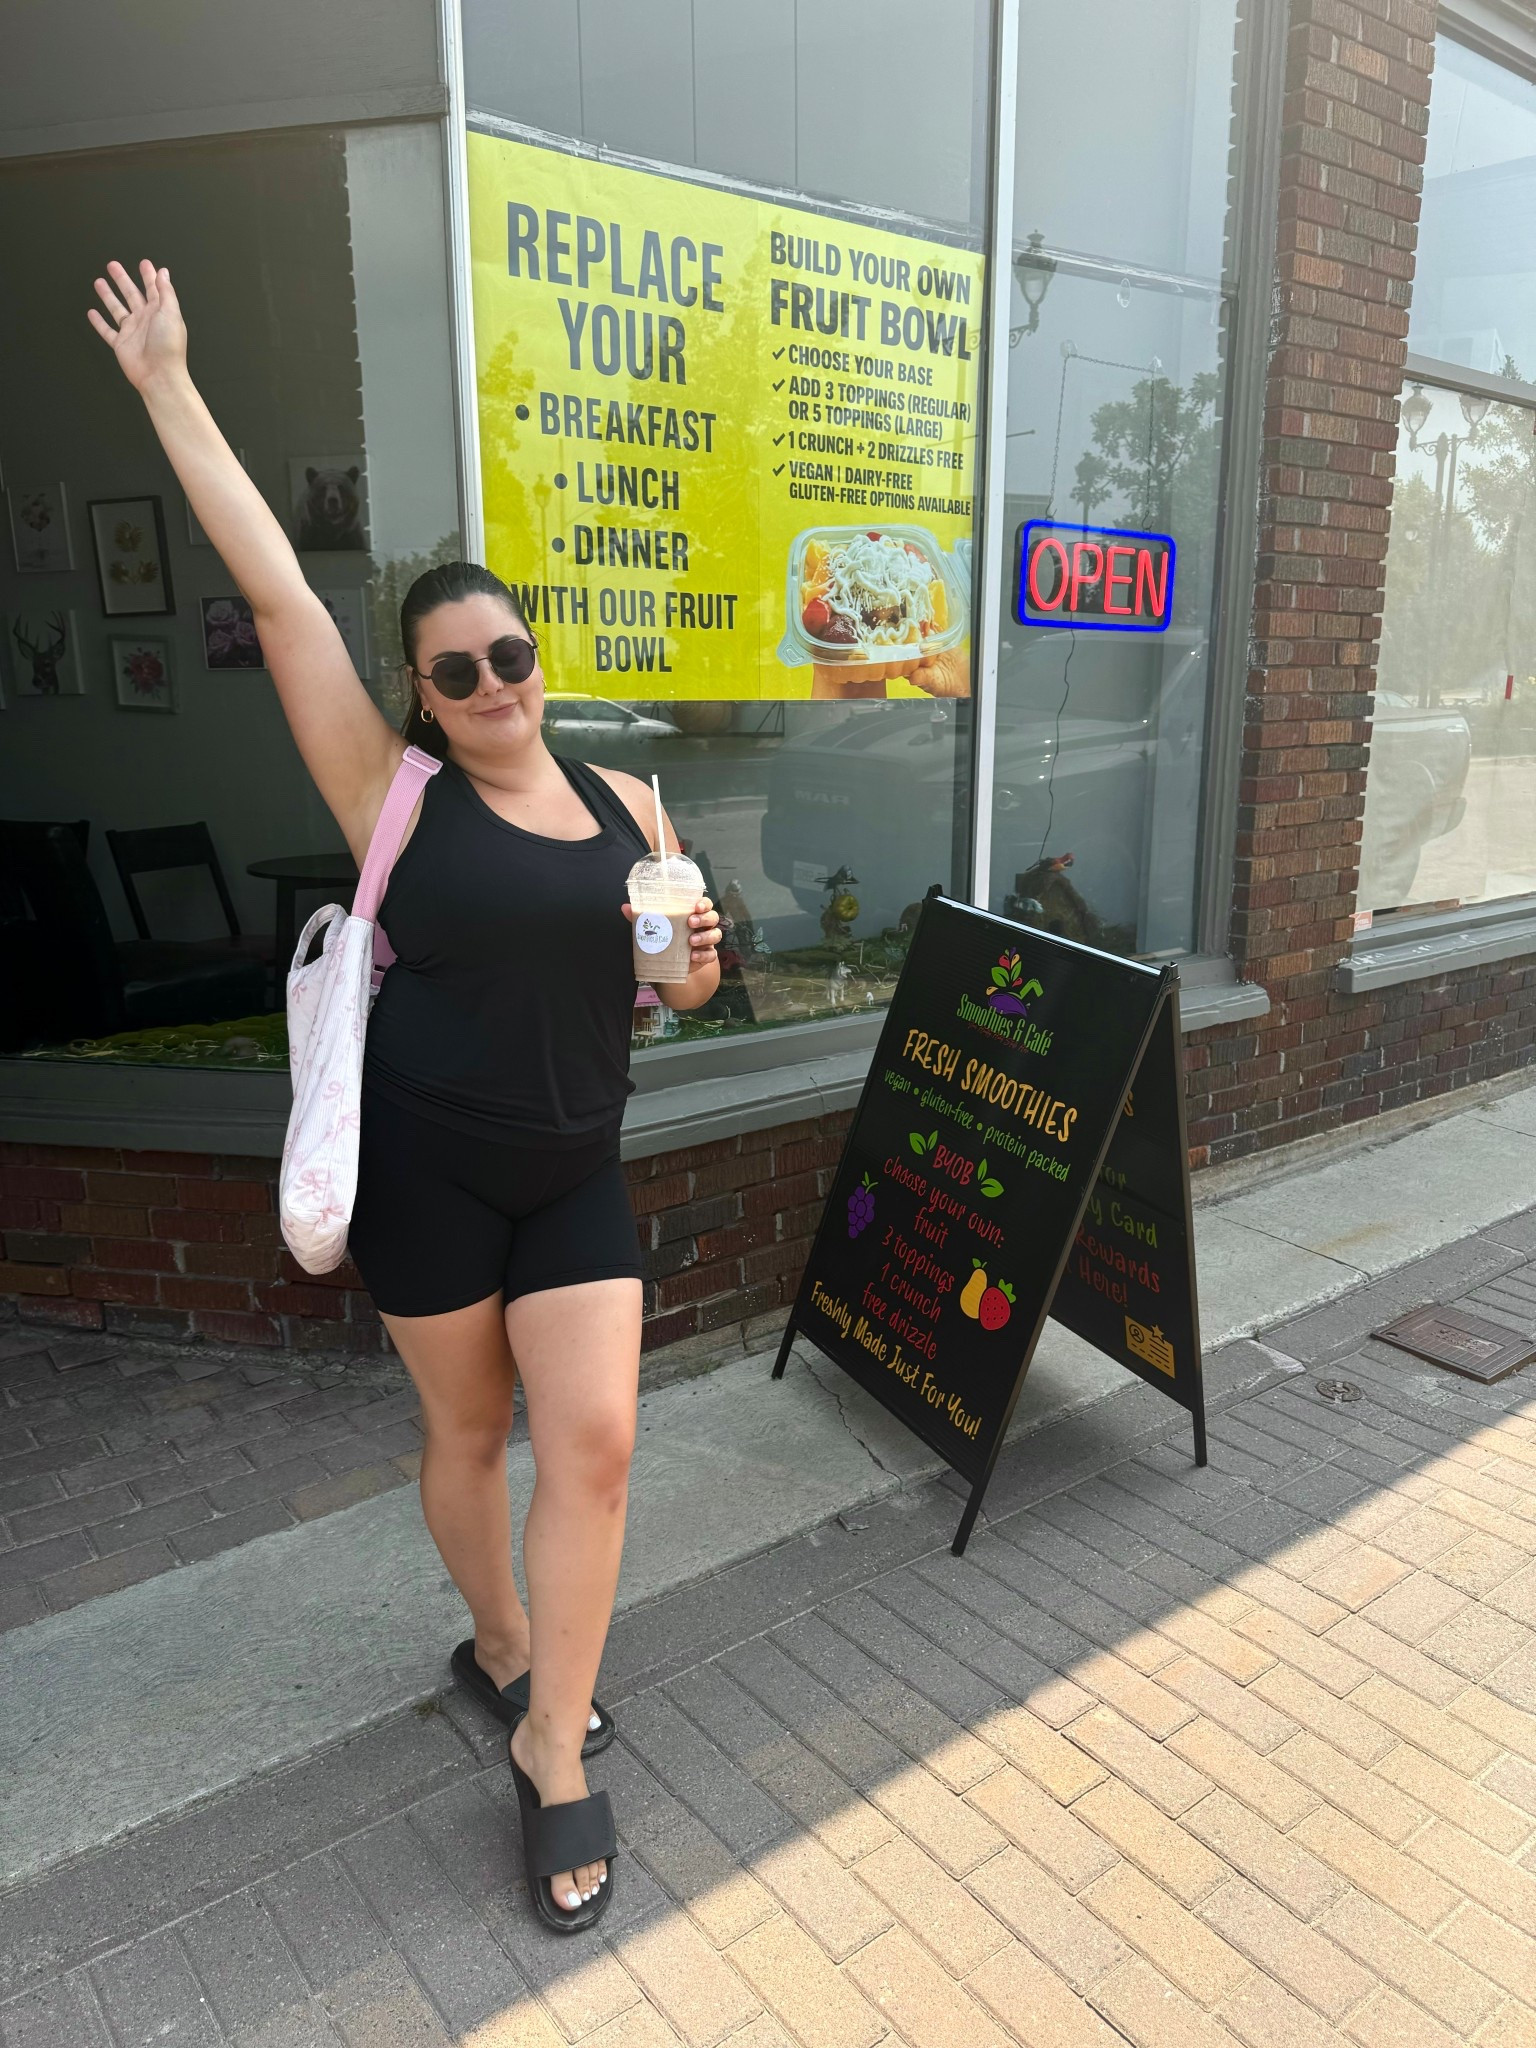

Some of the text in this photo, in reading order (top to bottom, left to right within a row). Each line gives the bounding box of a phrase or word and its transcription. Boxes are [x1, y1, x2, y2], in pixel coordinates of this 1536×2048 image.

[507, 201, 724, 313] REPLACE
[771, 231, 971, 305] BUILD YOUR OWN
[557, 298, 687, 385] YOUR
[771, 278, 971, 361] FRUIT BOWL
[788, 344, 933, 386] CHOOSE YOUR BASE
[540, 392, 716, 453] BREAKFAST
[788, 400, 943, 441] OR 5 TOPPINGS (LARGE)
[789, 375, 971, 423] ADD 3 TOPPINGS (REGULAR)
[788, 431, 794, 449] 1
[798, 432, 854, 456] CRUNCH
[867, 441, 876, 459] 2
[878, 442, 934, 466] DRIZZLES
[936, 450, 964, 470] FREE
[789, 460, 833, 482] VEGAN
[845, 467, 913, 490] DAIRY-FREE
[577, 462, 680, 511] LUNCH
[789, 482, 971, 516] GLUTEN-FREE OPTIONS AVAILABLE
[575, 524, 689, 571] DINNER
[1029, 537, 1169, 618] OPEN
[510, 584, 738, 629] WITH OUR FRUIT
[595, 635, 672, 672] BOWL
[956, 993, 1014, 1039] Smoothies
[1012, 1018, 1026, 1041] &
[1024, 1023, 1054, 1056] Café
[902, 1028, 962, 1082] FRESH
[960, 1058, 1078, 1143] SMOOTHIES
[884, 1068, 1071, 1183] vegan gluten-free protein packed
[932, 1144, 975, 1186] BYOB
[883, 1155, 1005, 1249] choose your own:
[914, 1207, 949, 1249] fruit
[1110, 1200, 1158, 1249] Card
[882, 1225, 956, 1294] 3 toppings
[863, 1281, 937, 1361] free drizzle
[880, 1262, 941, 1324] 1 crunch
[811, 1280, 983, 1441] Freshly Made Just For You!
